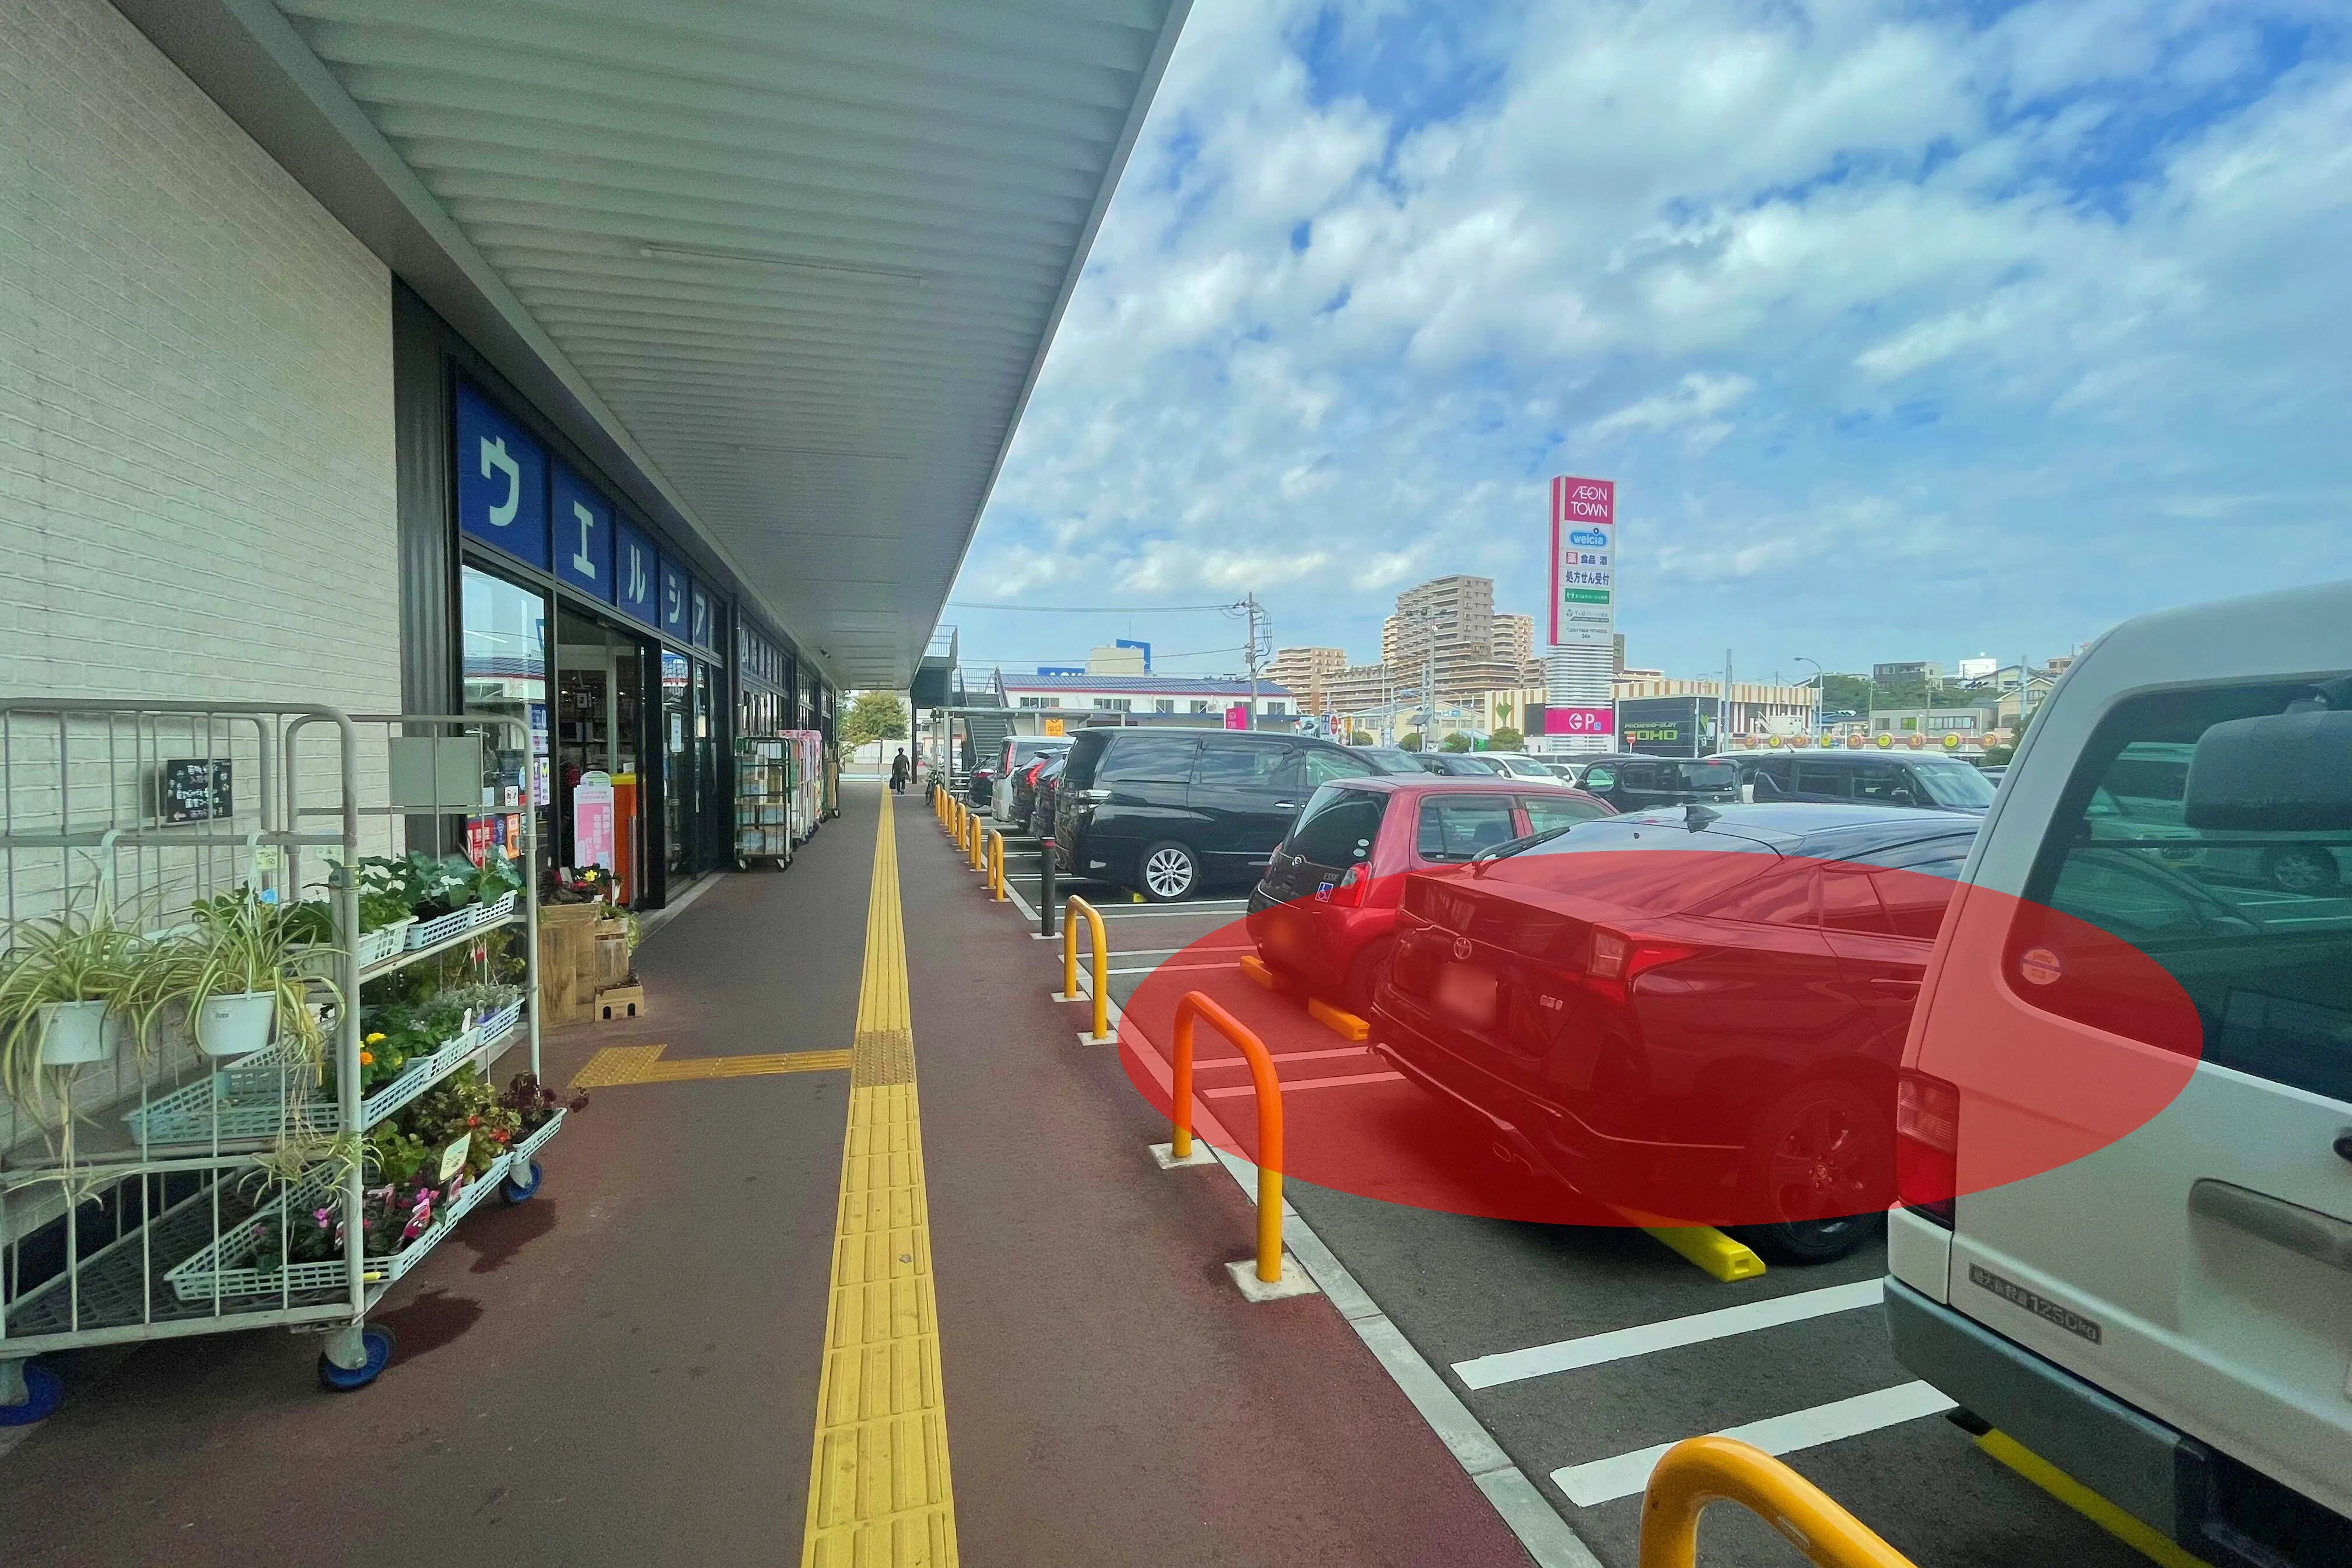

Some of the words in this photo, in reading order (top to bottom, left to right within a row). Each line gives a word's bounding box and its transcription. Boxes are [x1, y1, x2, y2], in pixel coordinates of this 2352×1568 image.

[1571, 501, 1608, 518] TOWN
[1573, 530, 1604, 545] welcia
[1581, 554, 1595, 564] 食品
[1600, 555, 1607, 565] 酒
[1566, 570, 1609, 585] 処方せん受付
[1586, 713, 1595, 730] P
